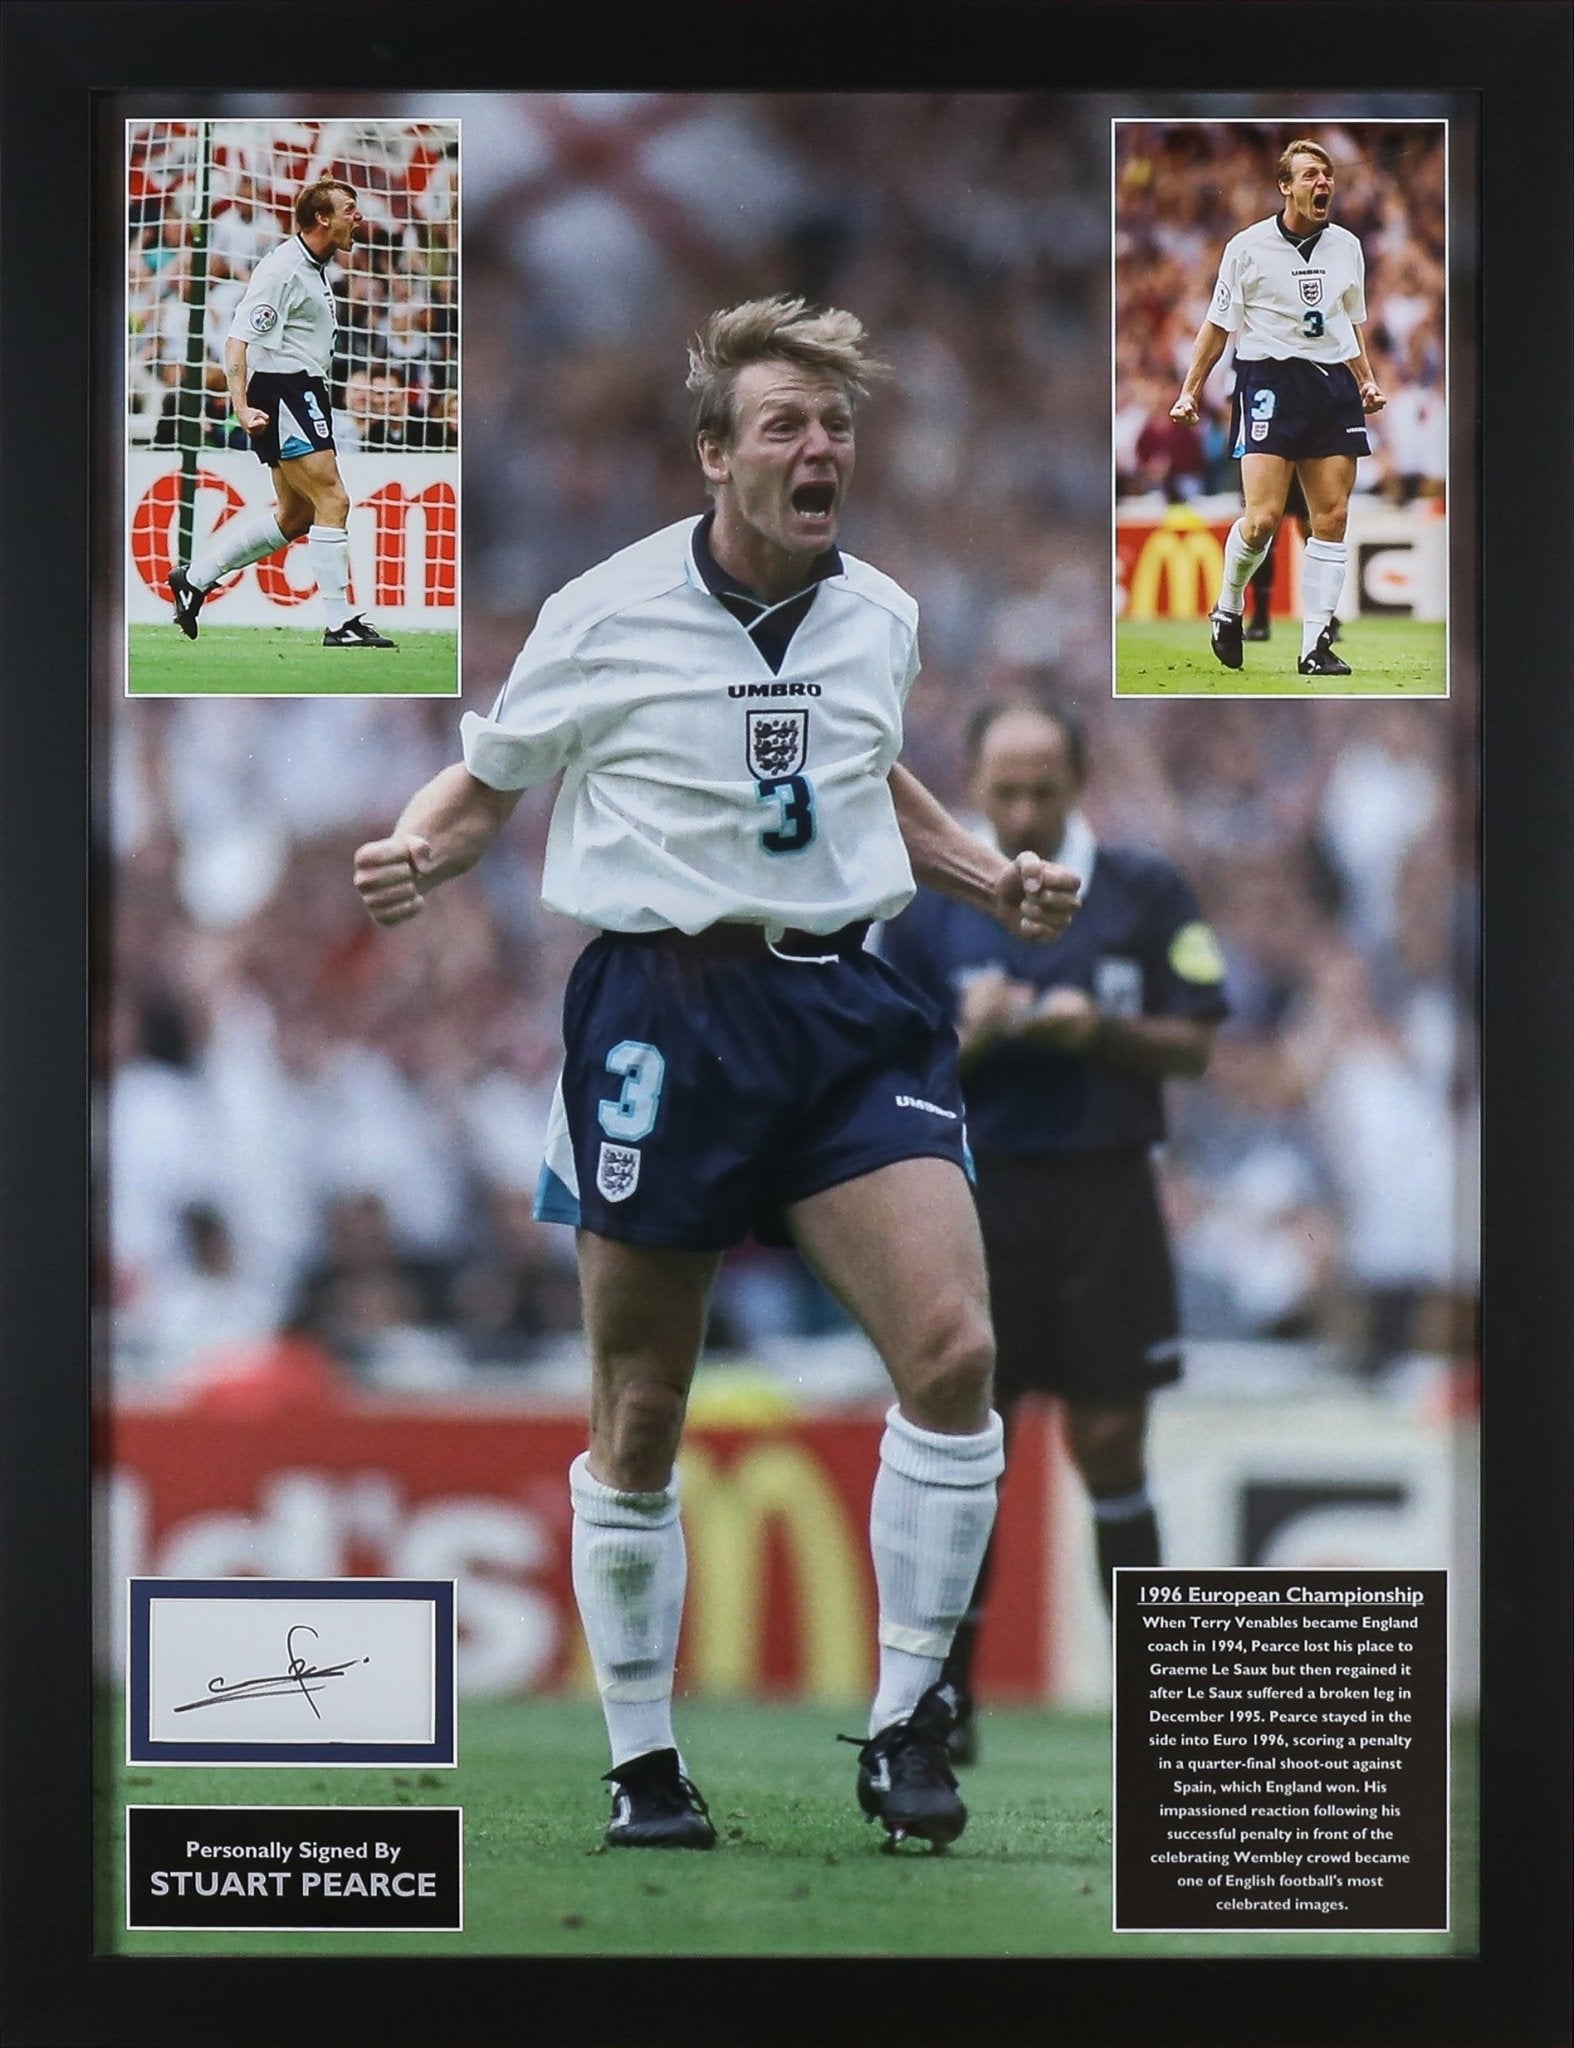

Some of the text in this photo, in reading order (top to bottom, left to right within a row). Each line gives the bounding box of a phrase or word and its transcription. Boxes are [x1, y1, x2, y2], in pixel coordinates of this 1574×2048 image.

[1302, 310, 1325, 338] 3
[303, 390, 324, 420] 3
[1251, 389, 1276, 420] 3
[727, 683, 823, 699] UMBRO
[756, 773, 816, 856] 3
[599, 1040, 666, 1142] 3
[1140, 1586, 1424, 1607] 1996 European Championship
[1142, 1615, 1419, 1632] When Terry Venables became England
[1147, 1639, 1414, 1656] coach in 1994, Pearce lost his place to
[1149, 1662, 1412, 1679] Graeme Le Saux but then regained it
[1149, 1686, 1412, 1703] after Le Saux suffered a broken leg in
[1149, 1709, 1412, 1726] December 1995. Pearce stayed in the
[1148, 1733, 1413, 1750] side into Euro 1996, scoring a penalty
[1158, 1756, 1403, 1773] in a quarter-final shoot-out against
[1173, 1780, 1388, 1797] Spain, which England won. His
[1159, 1803, 1401, 1820] impassioned reaction following his
[1167, 1827, 1394, 1844] successful penalty in front of the
[186, 1840, 402, 1864] Personally Signed By
[1150, 1850, 1411, 1867] celebrating Wembley crowd became
[150, 1870, 437, 1898] STUART PEARCE
[1177, 1874, 1384, 1890] one of English football's most
[1215, 1897, 1349, 1914] celebrated images.
